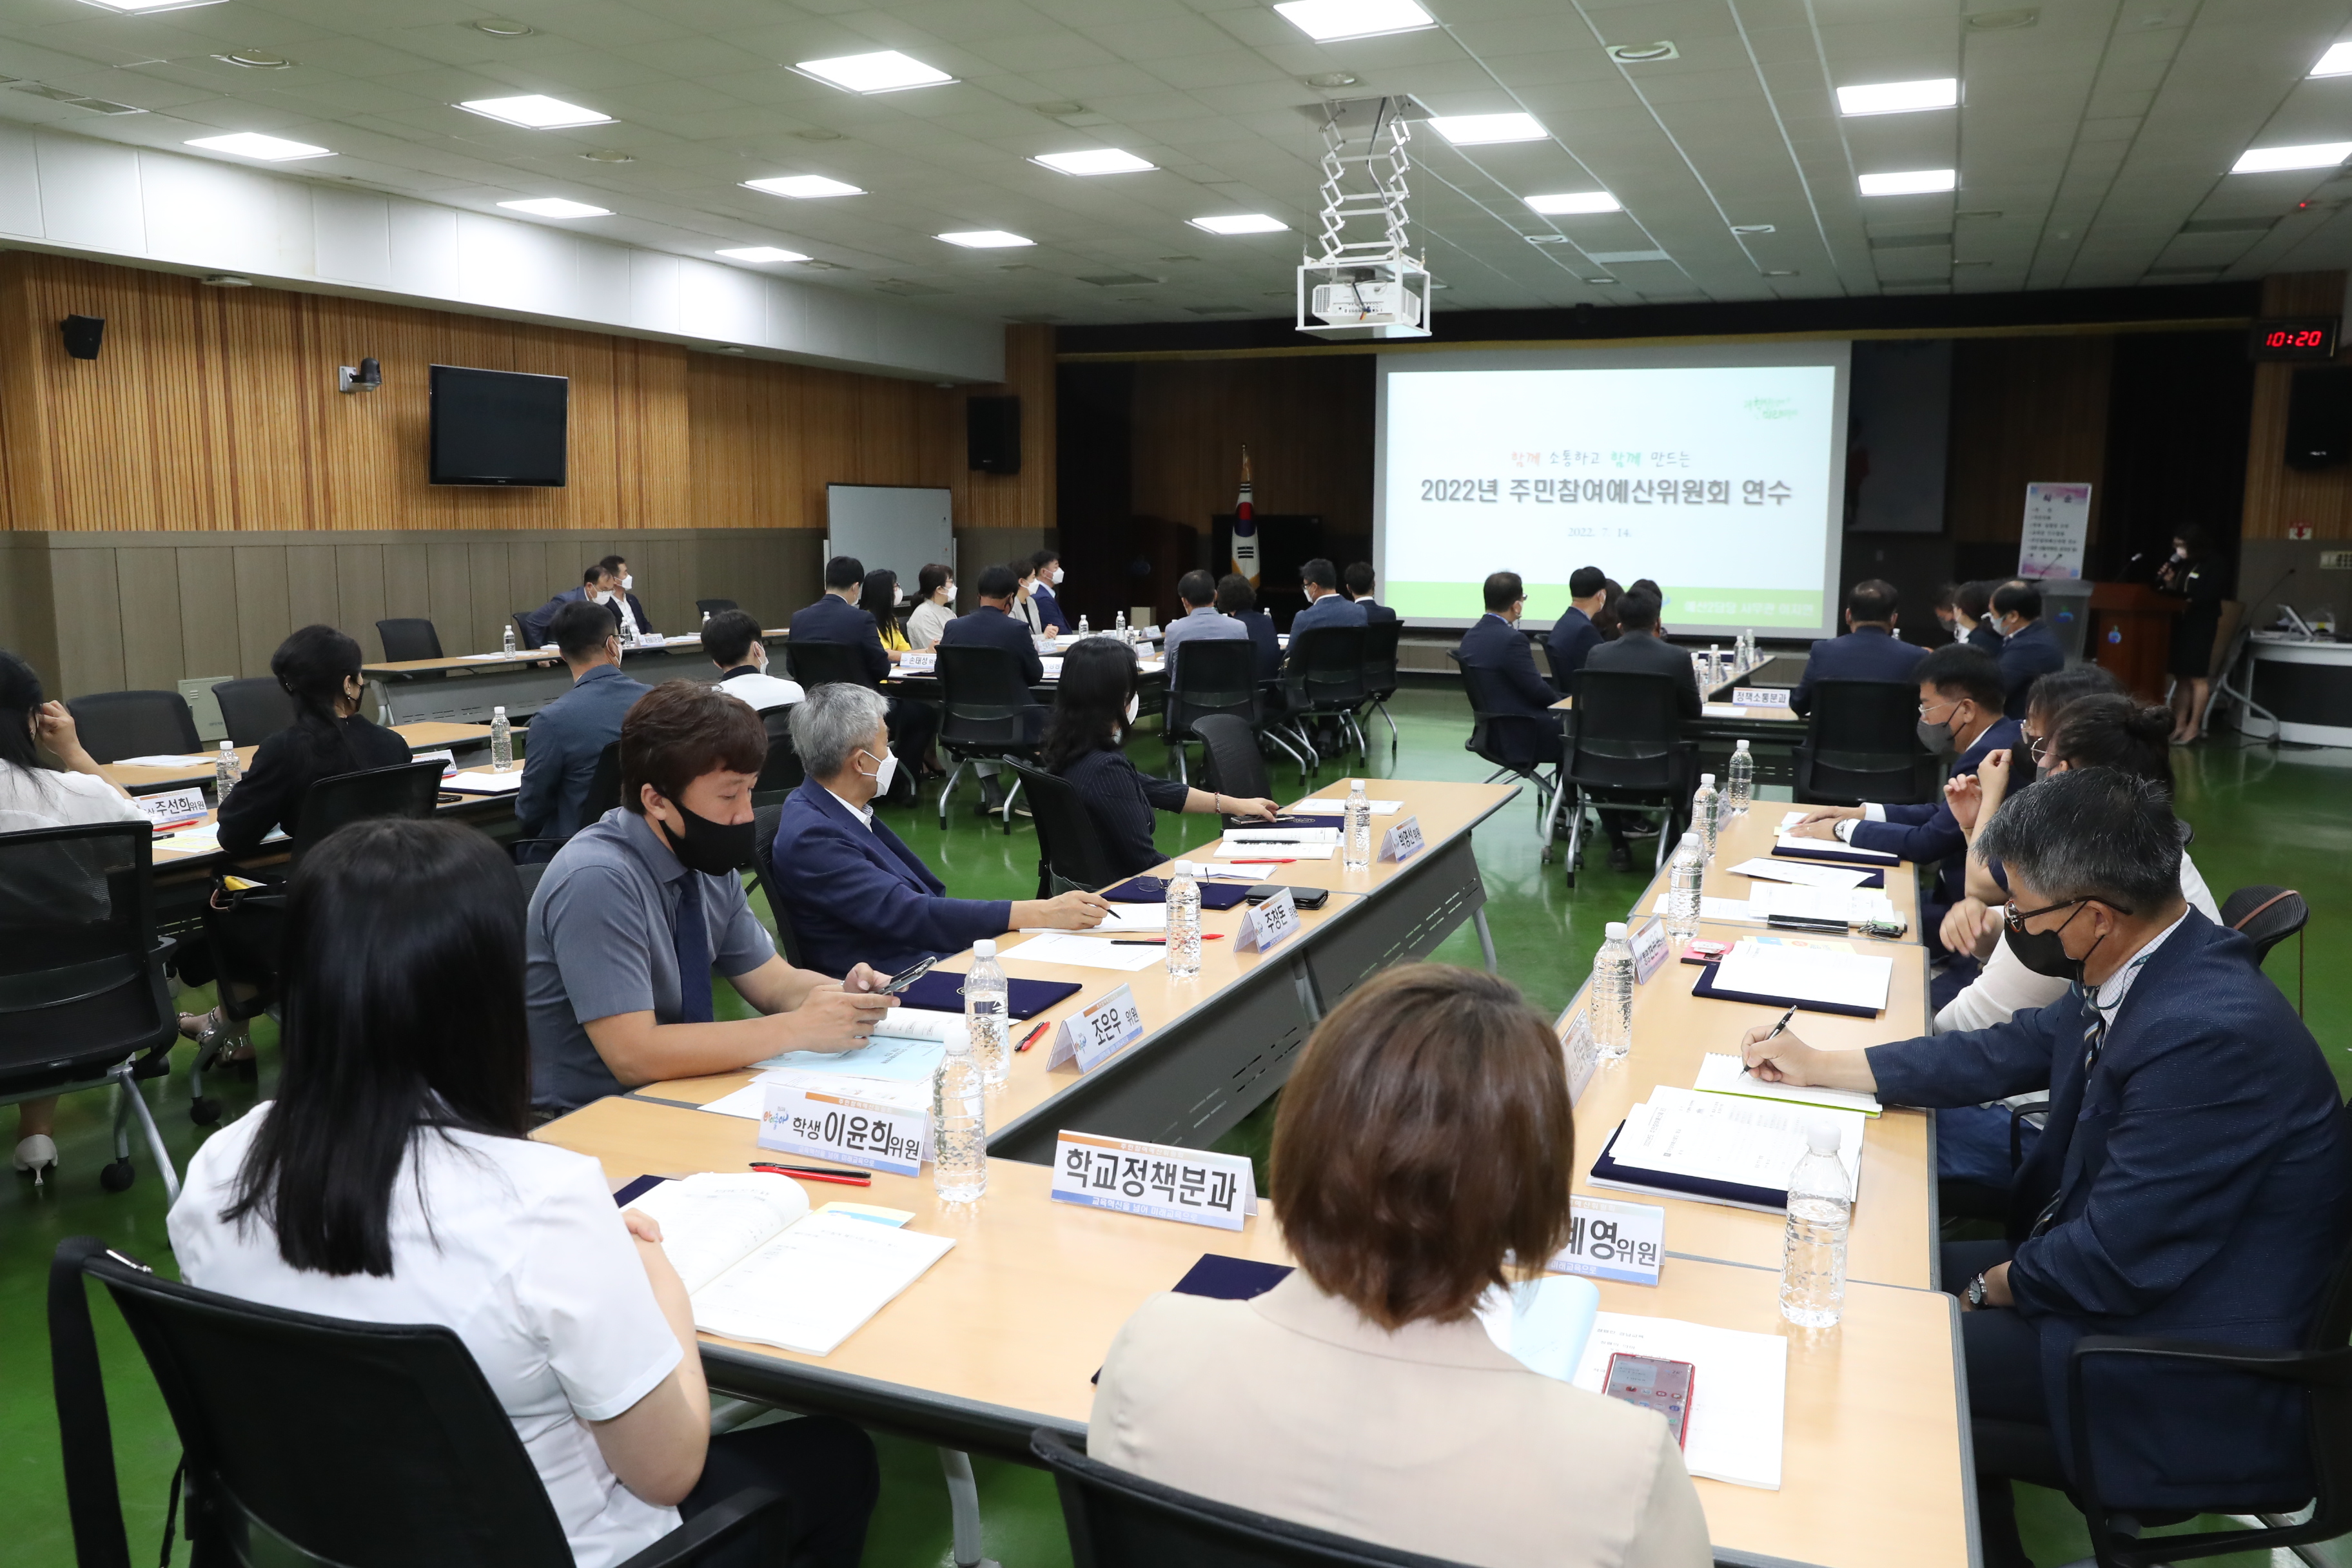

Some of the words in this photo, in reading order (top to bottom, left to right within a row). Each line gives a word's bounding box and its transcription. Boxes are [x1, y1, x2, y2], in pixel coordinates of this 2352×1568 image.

[2266, 331, 2322, 347] 10:20
[1511, 451, 1540, 467] 함께
[1549, 450, 1600, 467] 소통하고
[1610, 451, 1641, 468] 함께
[1651, 451, 1690, 468] 만드는
[1421, 479, 1498, 504] 2022년
[1509, 479, 1730, 505] 주민참여예산위원회
[1741, 479, 1792, 506] 연수
[1567, 527, 1596, 538] 2022.
[1737, 692, 1786, 703] 정책소통분과
[1398, 827, 1415, 848] 박영선
[1265, 905, 1288, 933] 주창돈
[1288, 906, 1298, 919] 위원
[1092, 1008, 1121, 1046] 조은우
[1125, 1006, 1139, 1026] 위원
[792, 1117, 821, 1141] 학생
[1121, 1142, 1184, 1159] 주민참여예산위원회
[1066, 1148, 1237, 1212] 학교정책분과
[1092, 1196, 1130, 1213] 교육혁신을
[1133, 1202, 1148, 1215] 넘어
[1150, 1204, 1198, 1222] 미래교육으로
